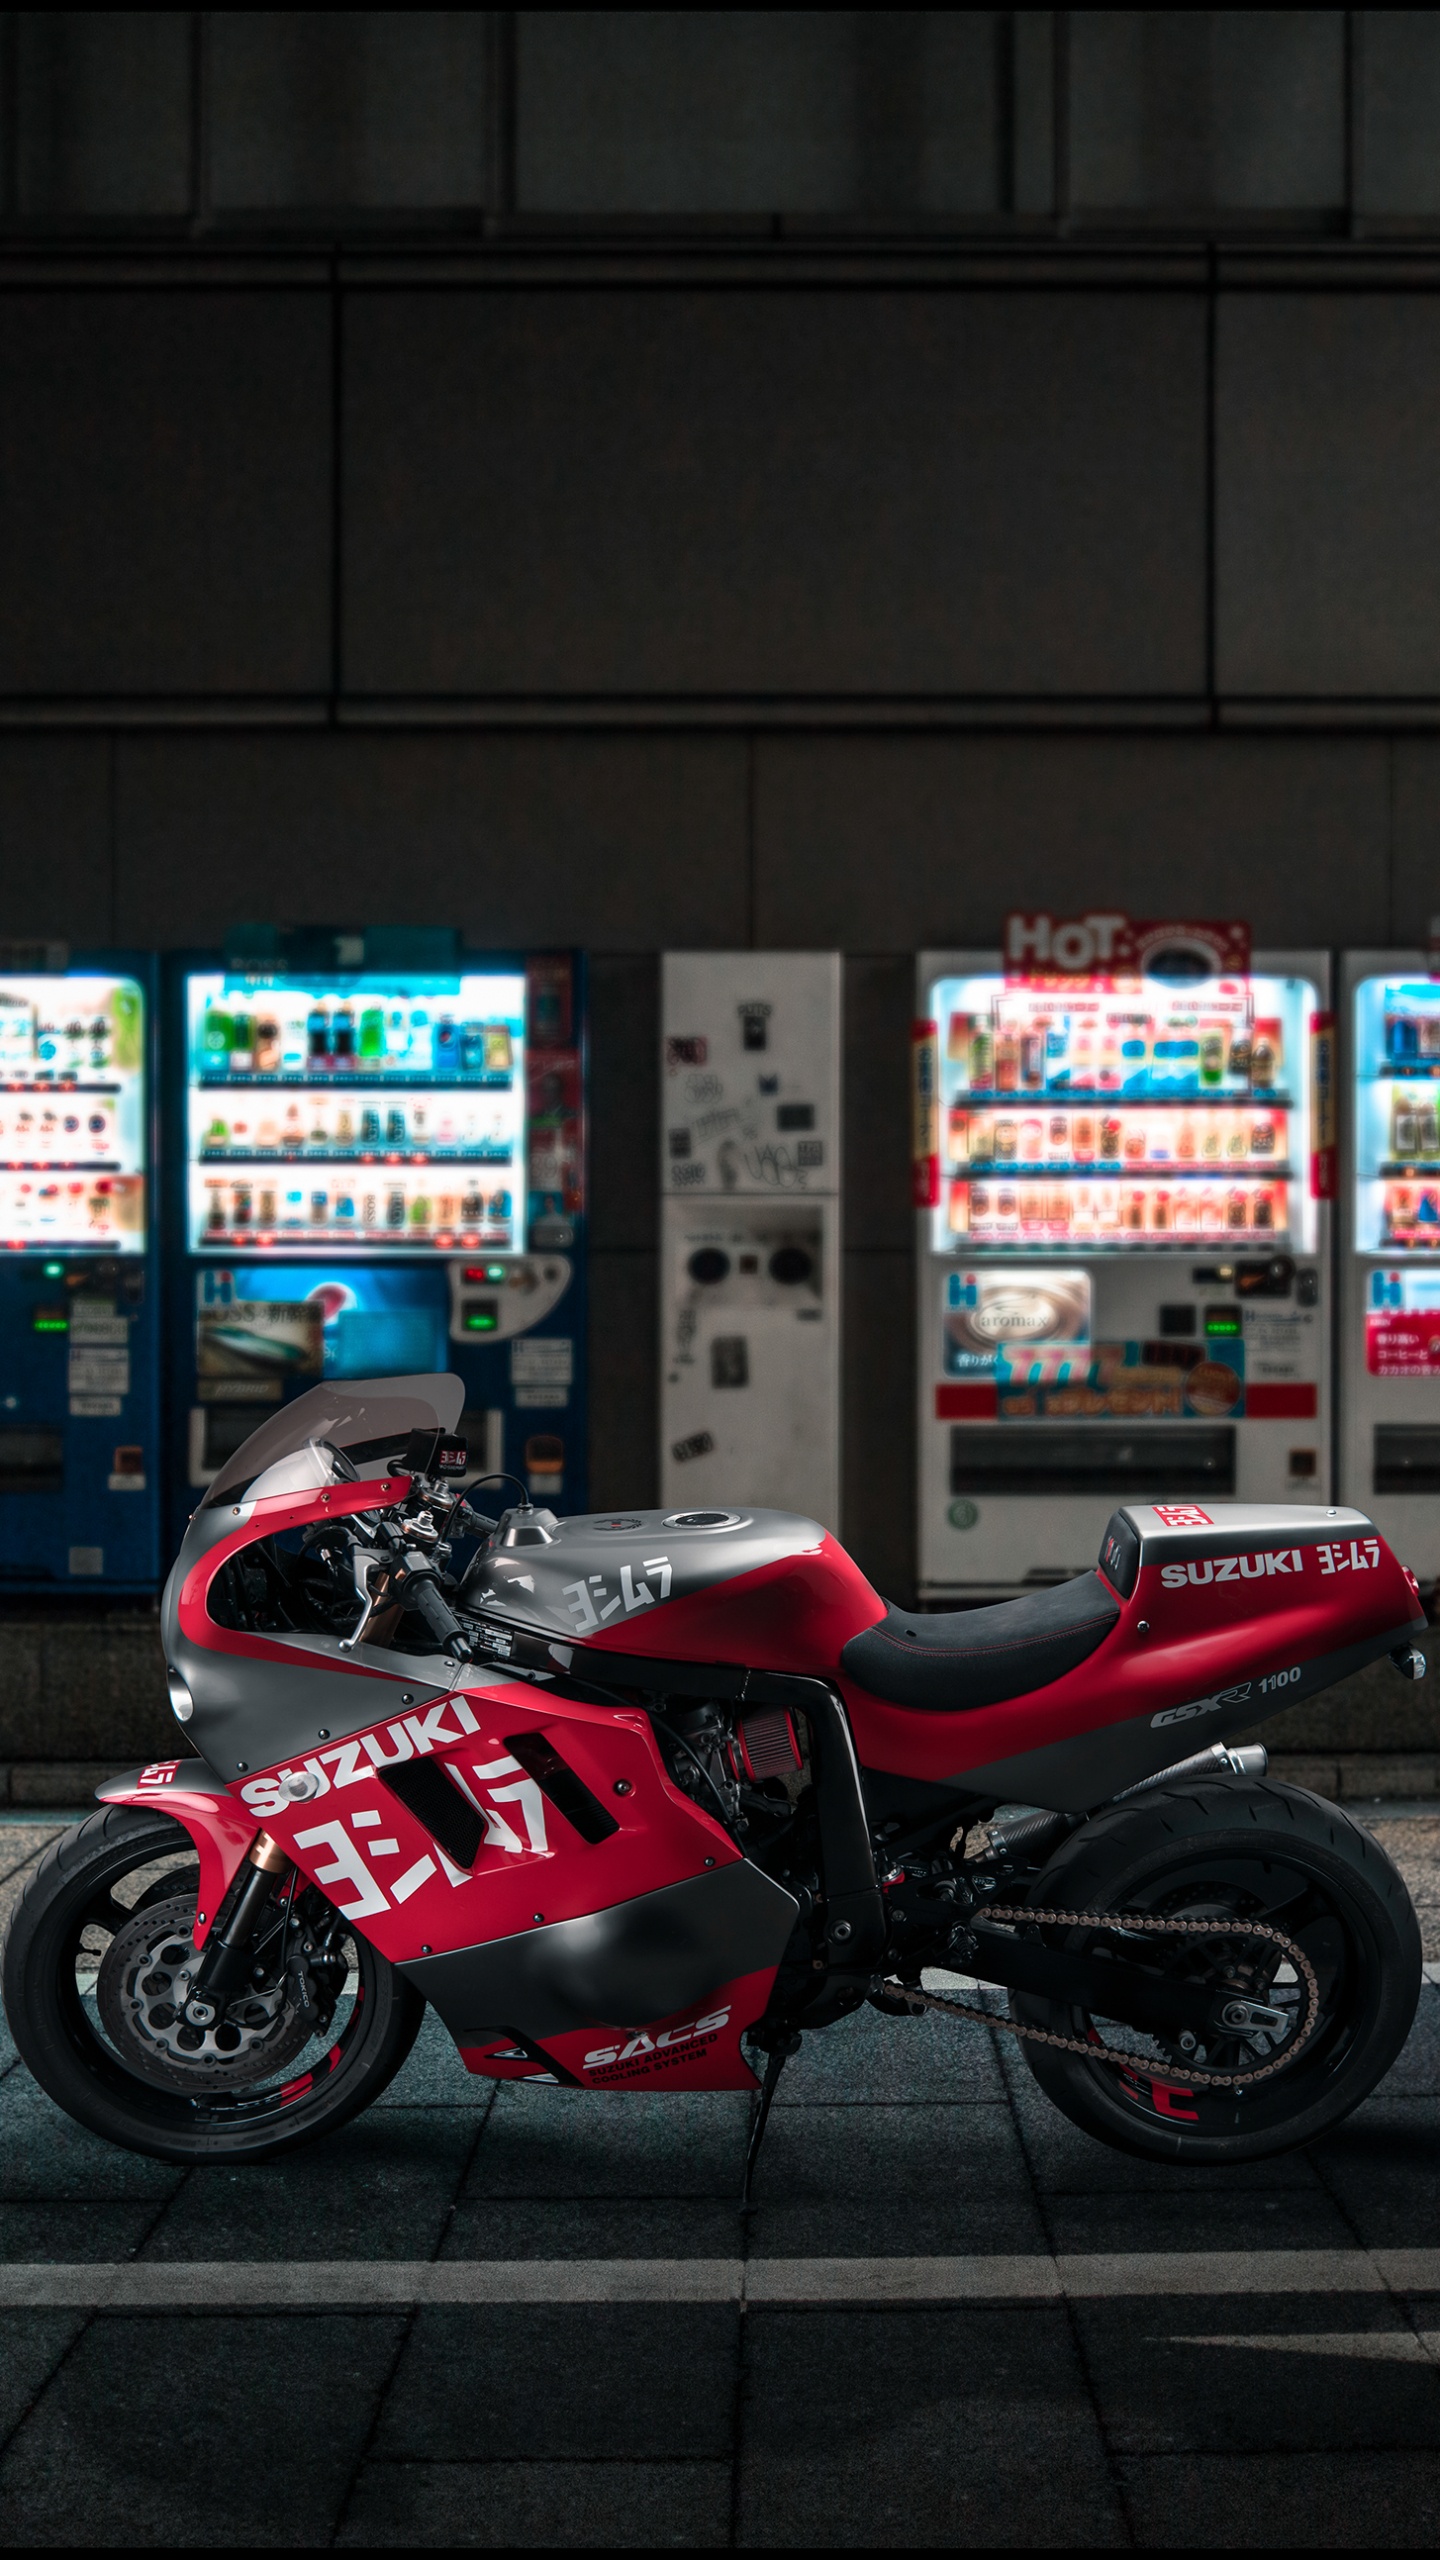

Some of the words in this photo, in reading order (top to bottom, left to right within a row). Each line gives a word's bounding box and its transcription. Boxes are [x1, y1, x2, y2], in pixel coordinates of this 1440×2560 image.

[1008, 914, 1126, 970] HOT
[367, 1194, 377, 1223] BOSS
[981, 1315, 1049, 1328] aromax
[1376, 1333, 1420, 1345] 香り高い
[1378, 1349, 1429, 1360] コーヒーと
[1161, 1549, 1304, 1589] SUZUKI
[1316, 1539, 1381, 1575] ヨシムラ
[561, 1556, 673, 1633] ヨシムラ
[1258, 1666, 1301, 1693] 1100
[240, 1695, 482, 1818] SUZUKI
[297, 1970, 310, 2008] TOKICO
[582, 2004, 732, 2070] SACS
[588, 2058, 640, 2077] SUZUKI
[643, 2033, 719, 2064] ADVANCED
[591, 2065, 650, 2085] COOLING
[653, 2048, 708, 2072] SYSTEM
